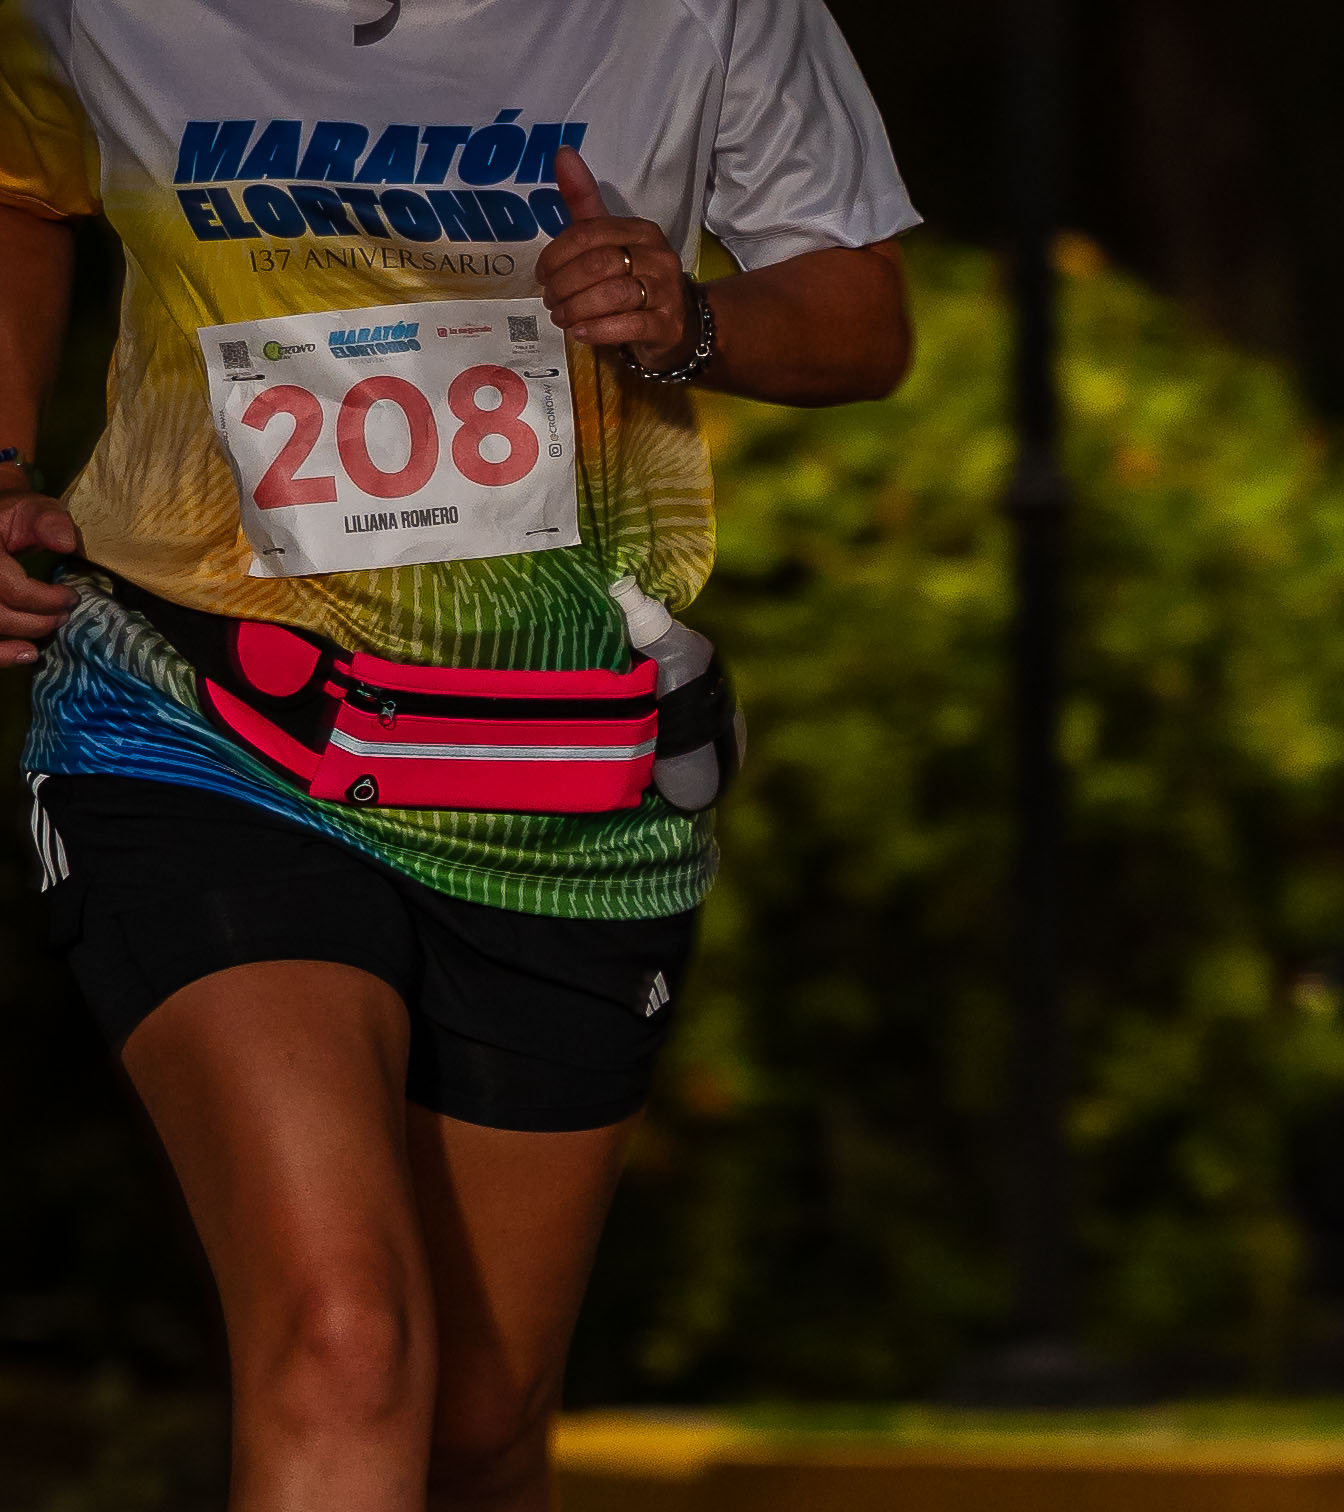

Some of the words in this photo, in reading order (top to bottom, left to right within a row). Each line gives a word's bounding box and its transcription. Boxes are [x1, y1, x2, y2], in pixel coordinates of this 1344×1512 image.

[172, 109, 588, 185] MARATÓN
[176, 184, 572, 243] ELORTONDO
[249, 249, 291, 274] 137
[304, 247, 515, 276] ANIVERSARIO
[328, 321, 419, 346] MARATÓN
[329, 339, 422, 359] ELORTONDO
[543, 383, 559, 442] @CRONORAV
[242, 364, 539, 511] 208
[344, 510, 398, 535] LILIANA
[401, 505, 458, 529] ROMERO
